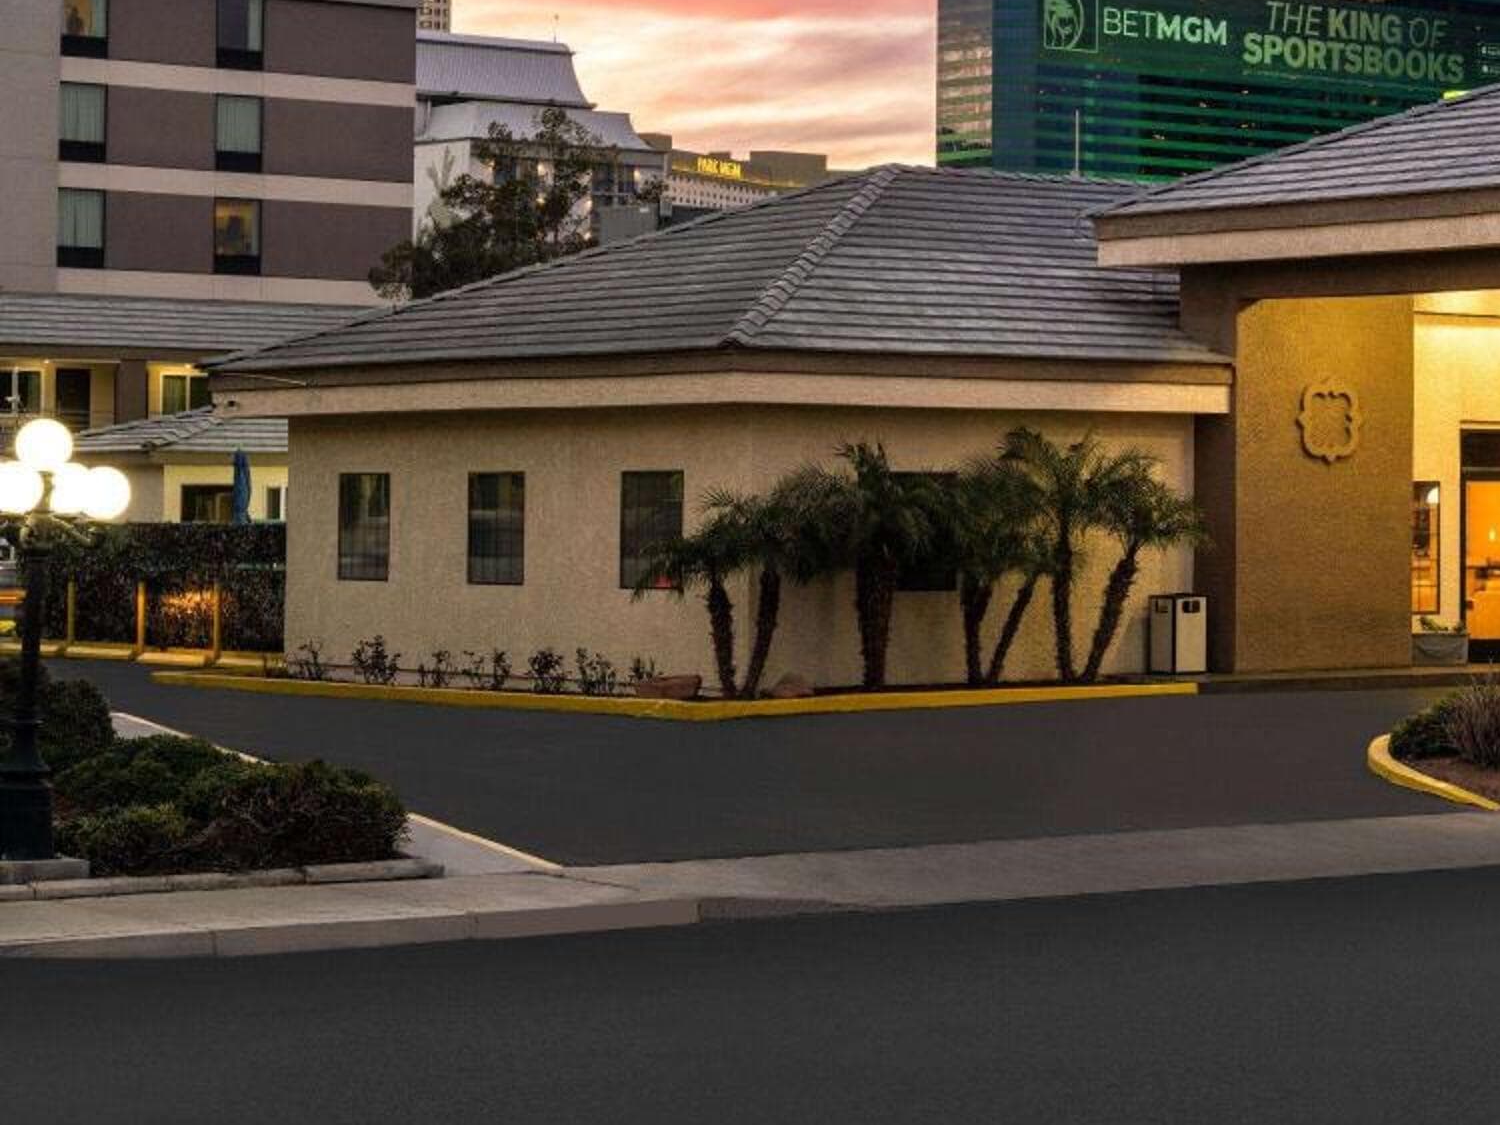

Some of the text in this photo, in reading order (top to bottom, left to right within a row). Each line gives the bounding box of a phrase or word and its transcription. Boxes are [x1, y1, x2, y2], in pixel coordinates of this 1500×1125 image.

[1103, 7, 1227, 46] BETMGM
[1266, 0, 1448, 48] THE KING OF
[1242, 32, 1465, 83] SPORTSBOOKS
